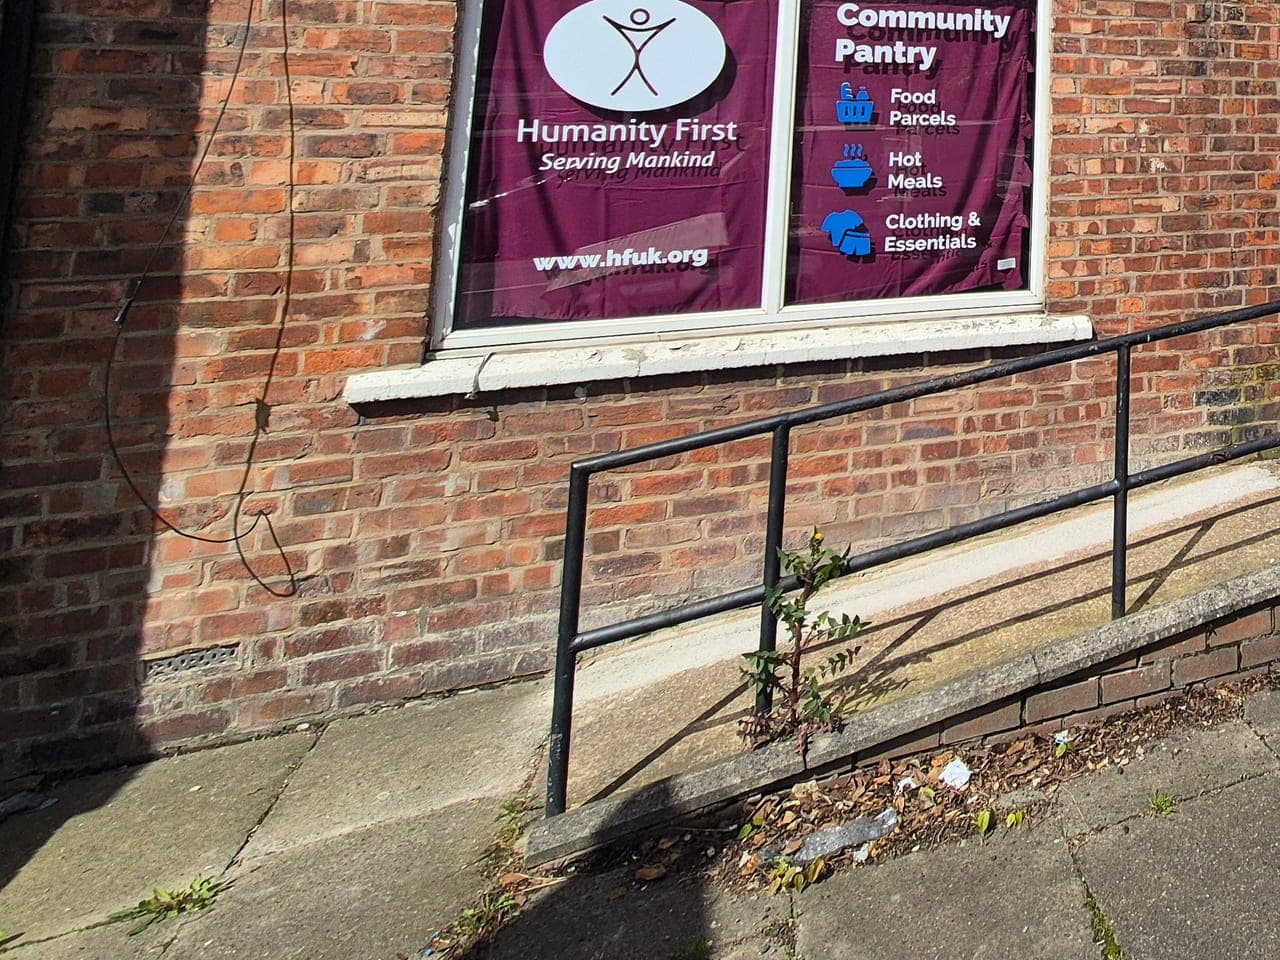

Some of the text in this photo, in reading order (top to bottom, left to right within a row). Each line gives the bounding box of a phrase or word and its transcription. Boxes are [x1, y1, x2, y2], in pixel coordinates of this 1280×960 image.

[835, 2, 1011, 39] Community
[835, 39, 937, 70] Pantry
[890, 88, 936, 104] Food
[889, 110, 956, 126] Parcels
[516, 118, 738, 148] Humanity First
[538, 151, 716, 173] Serving Mankind
[888, 151, 922, 167] Hot
[887, 173, 943, 189] Meals
[885, 211, 981, 230] Clothing &
[884, 233, 977, 252] Essentials
[533, 247, 709, 271] www.hfuk.org
